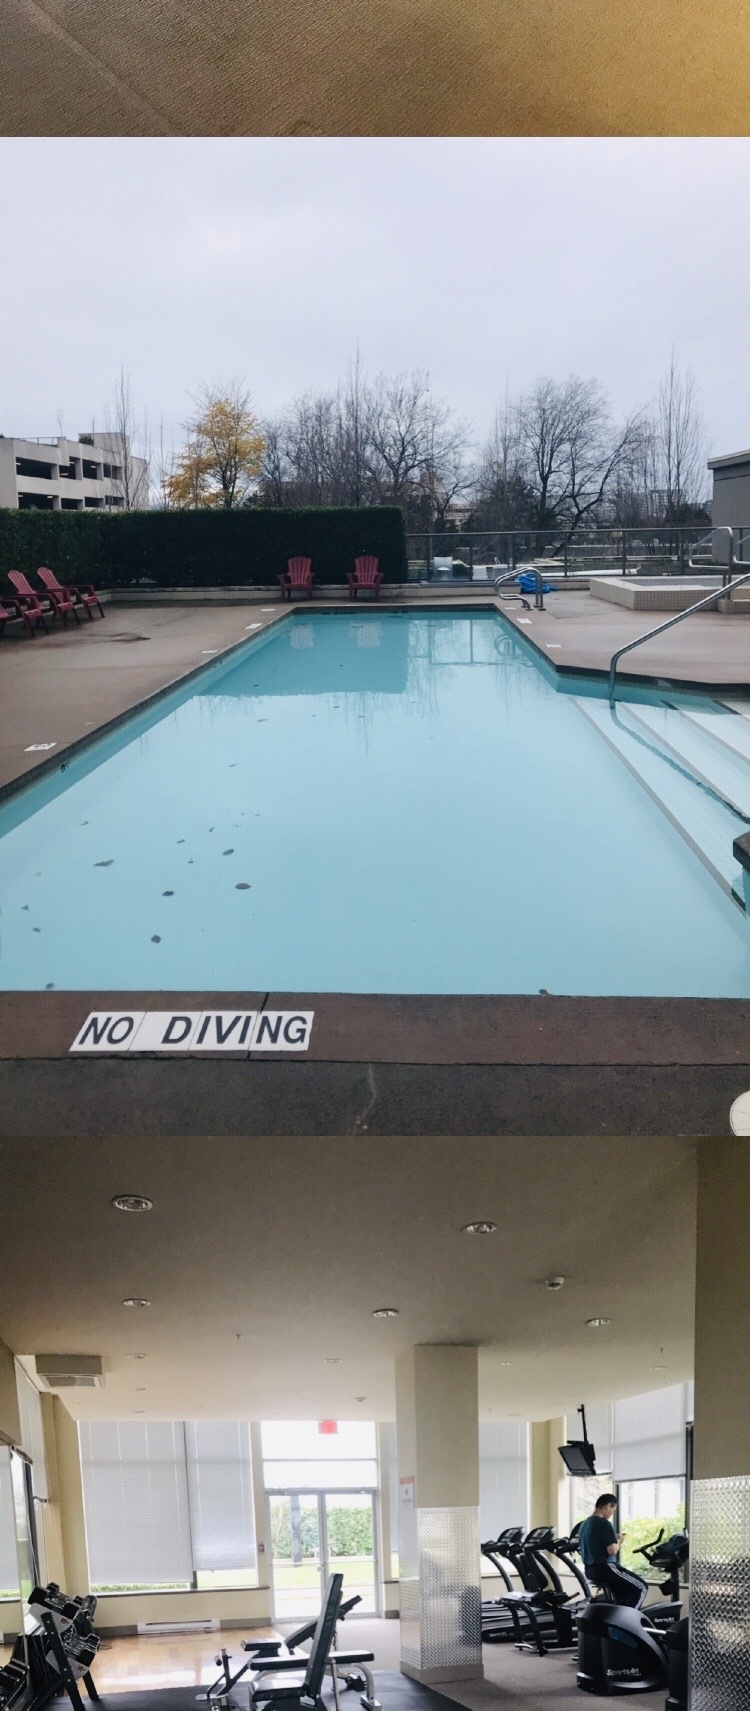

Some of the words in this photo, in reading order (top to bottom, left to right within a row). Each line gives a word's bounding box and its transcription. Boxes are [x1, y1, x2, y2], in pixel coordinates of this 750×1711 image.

[78, 1016, 134, 1045] NO
[161, 1015, 308, 1044] DIVING
[606, 1667, 640, 1676] SportsArt
